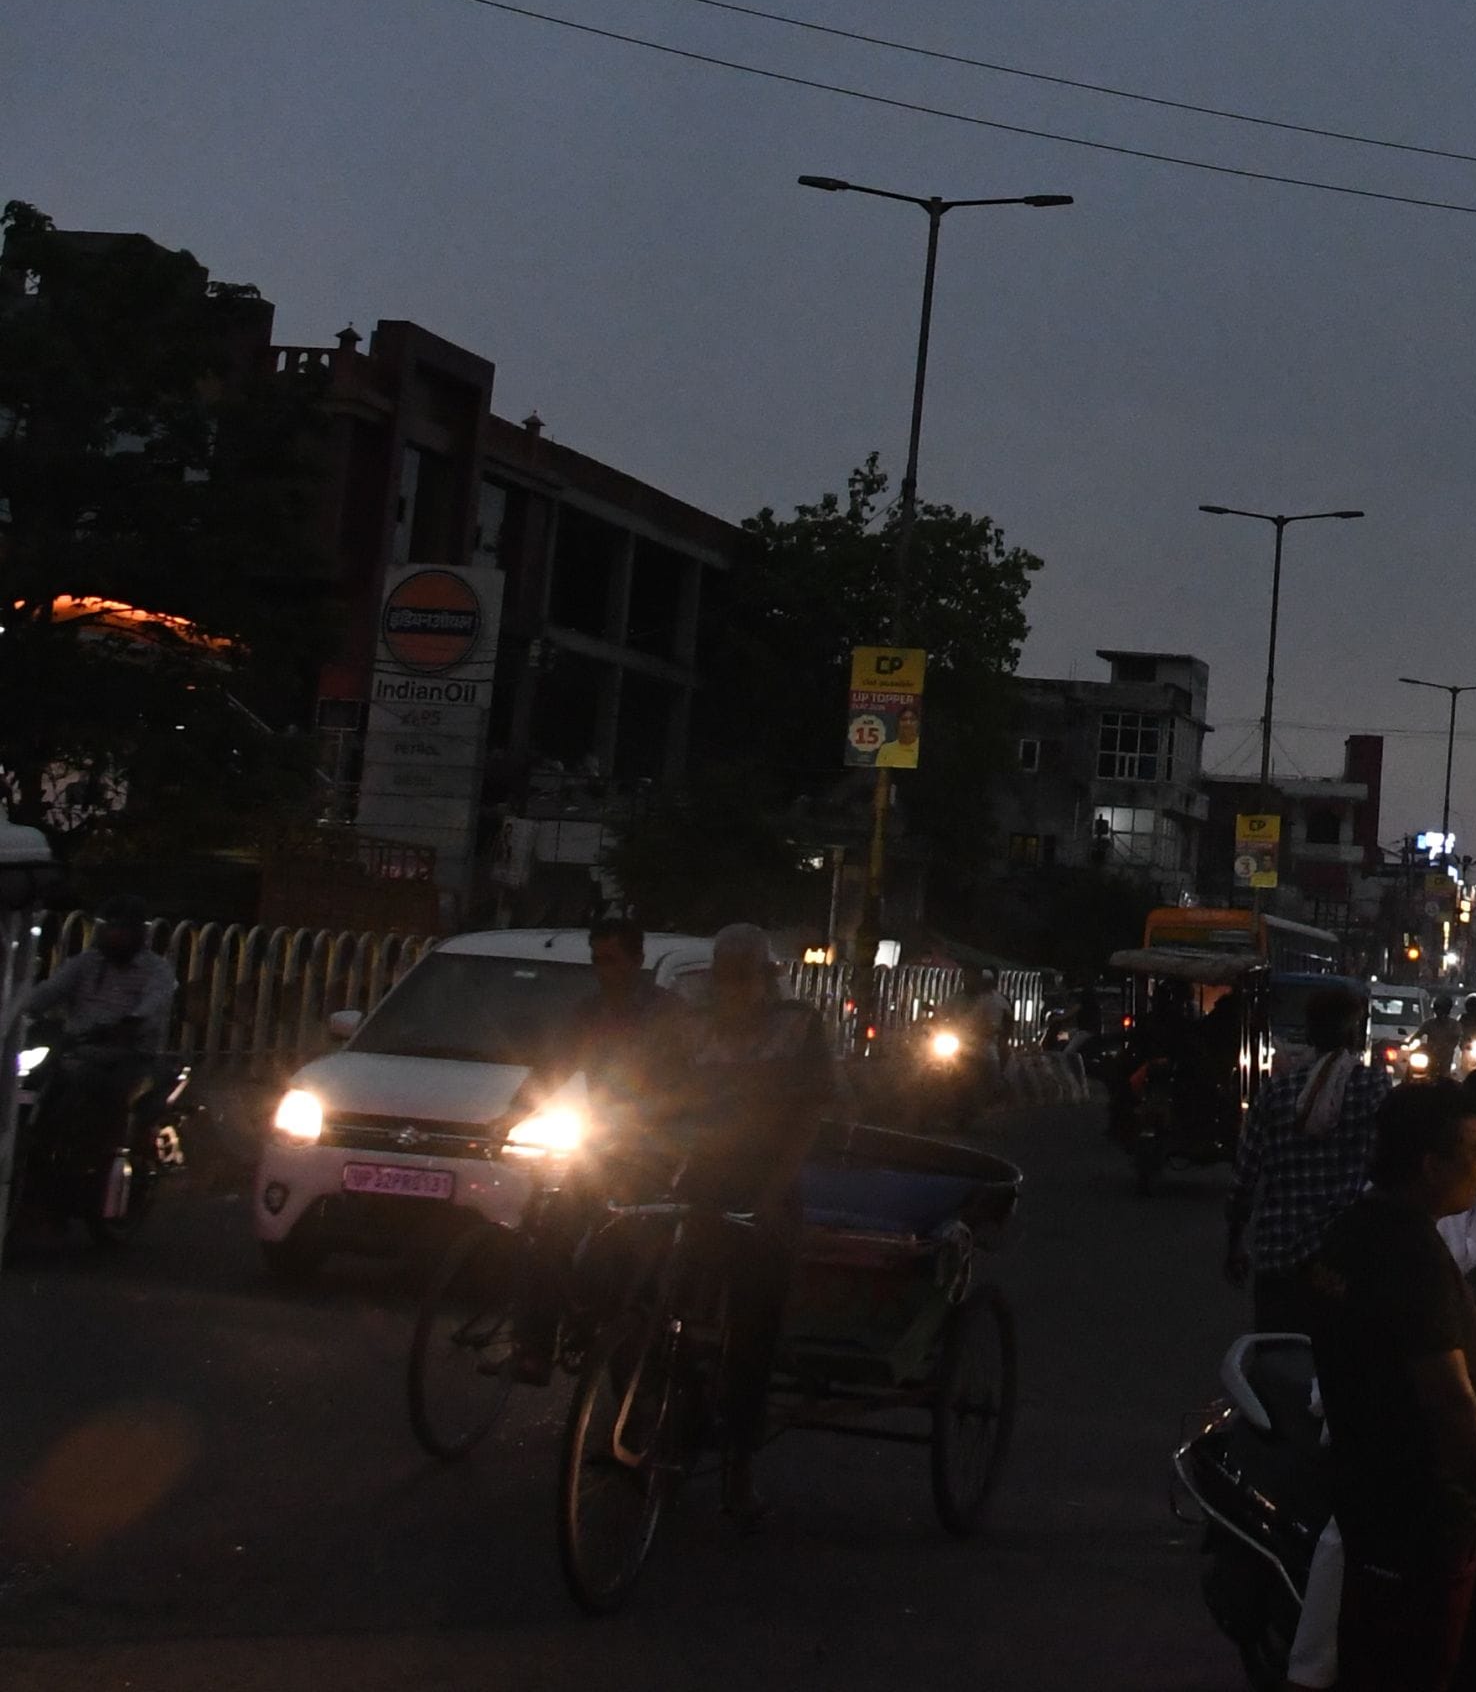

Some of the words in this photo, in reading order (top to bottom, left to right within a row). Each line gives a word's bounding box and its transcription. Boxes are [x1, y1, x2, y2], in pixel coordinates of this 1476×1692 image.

[875, 655, 904, 675] CP
[376, 679, 477, 703] IndianOil
[871, 693, 914, 705] TOPPER
[855, 727, 879, 745] 15
